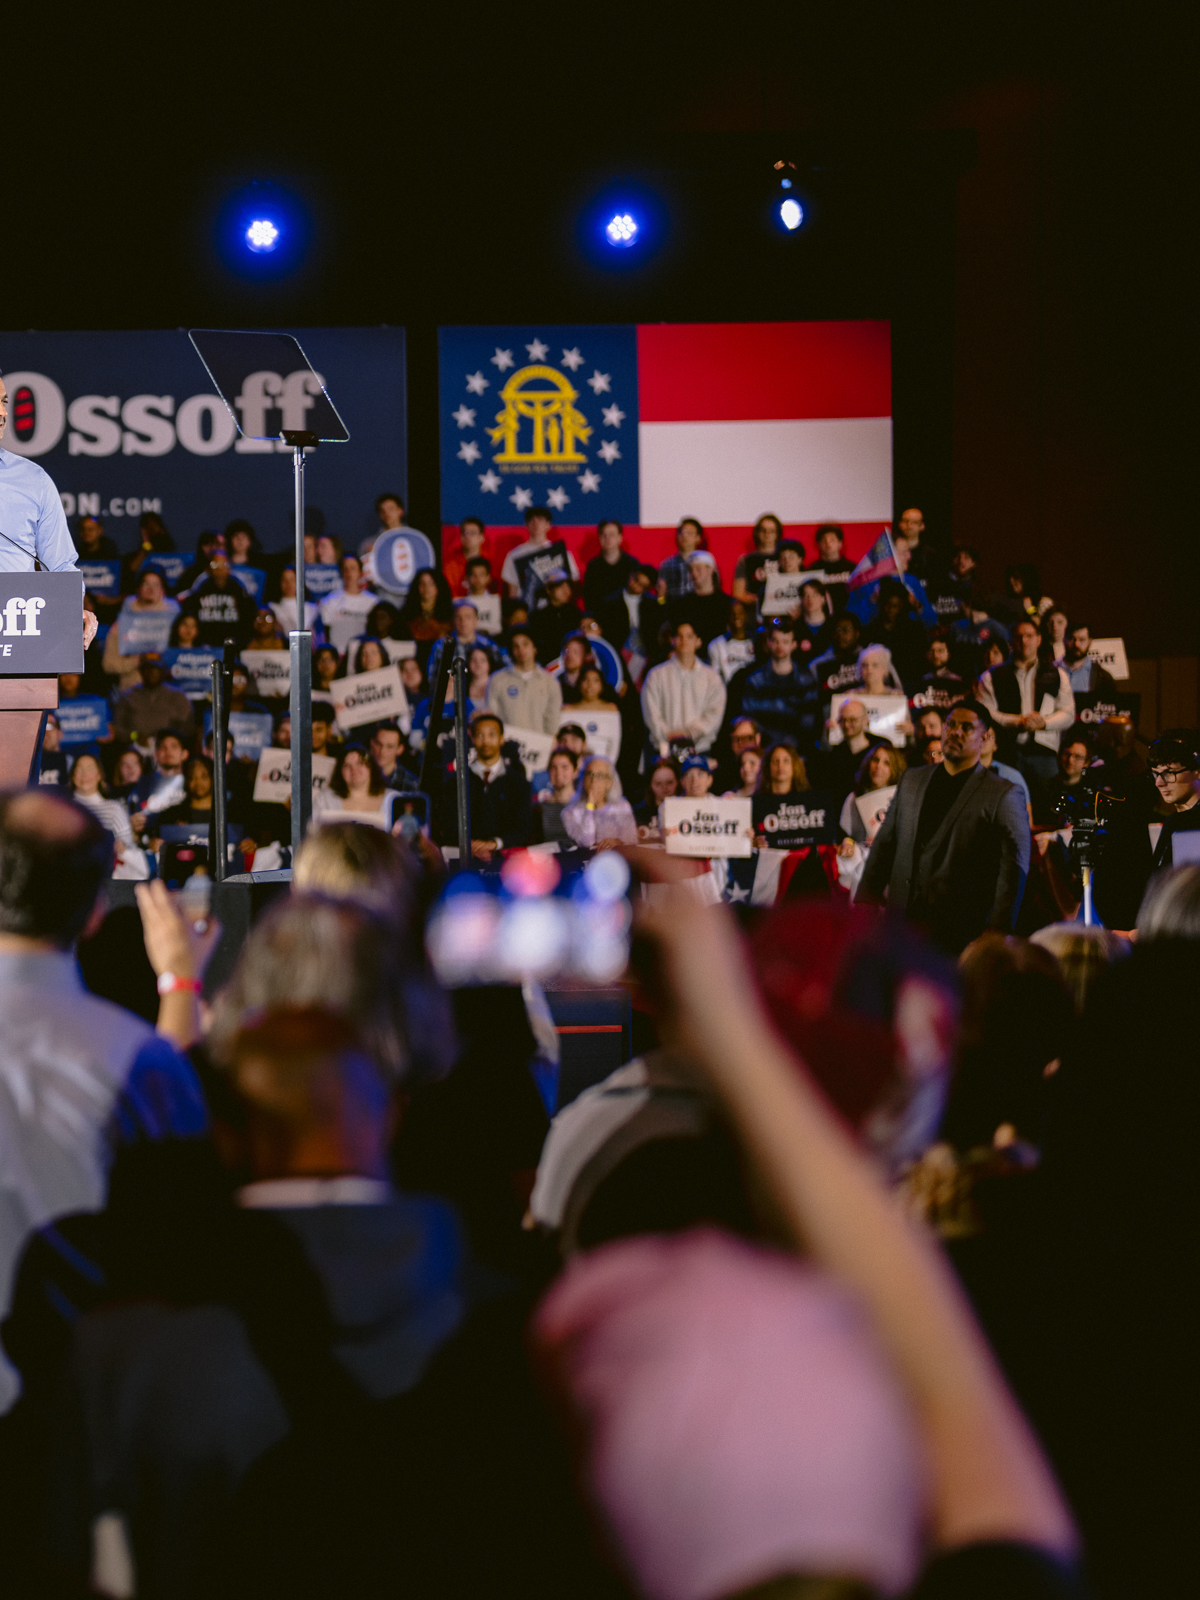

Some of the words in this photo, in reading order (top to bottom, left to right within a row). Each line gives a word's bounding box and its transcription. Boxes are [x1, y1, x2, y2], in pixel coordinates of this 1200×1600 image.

[61, 492, 162, 517] ON.COM
[692, 809, 720, 822] Jon
[777, 802, 806, 817] Jon
[679, 820, 740, 836] Ossoff
[763, 809, 826, 833] Ossoff
